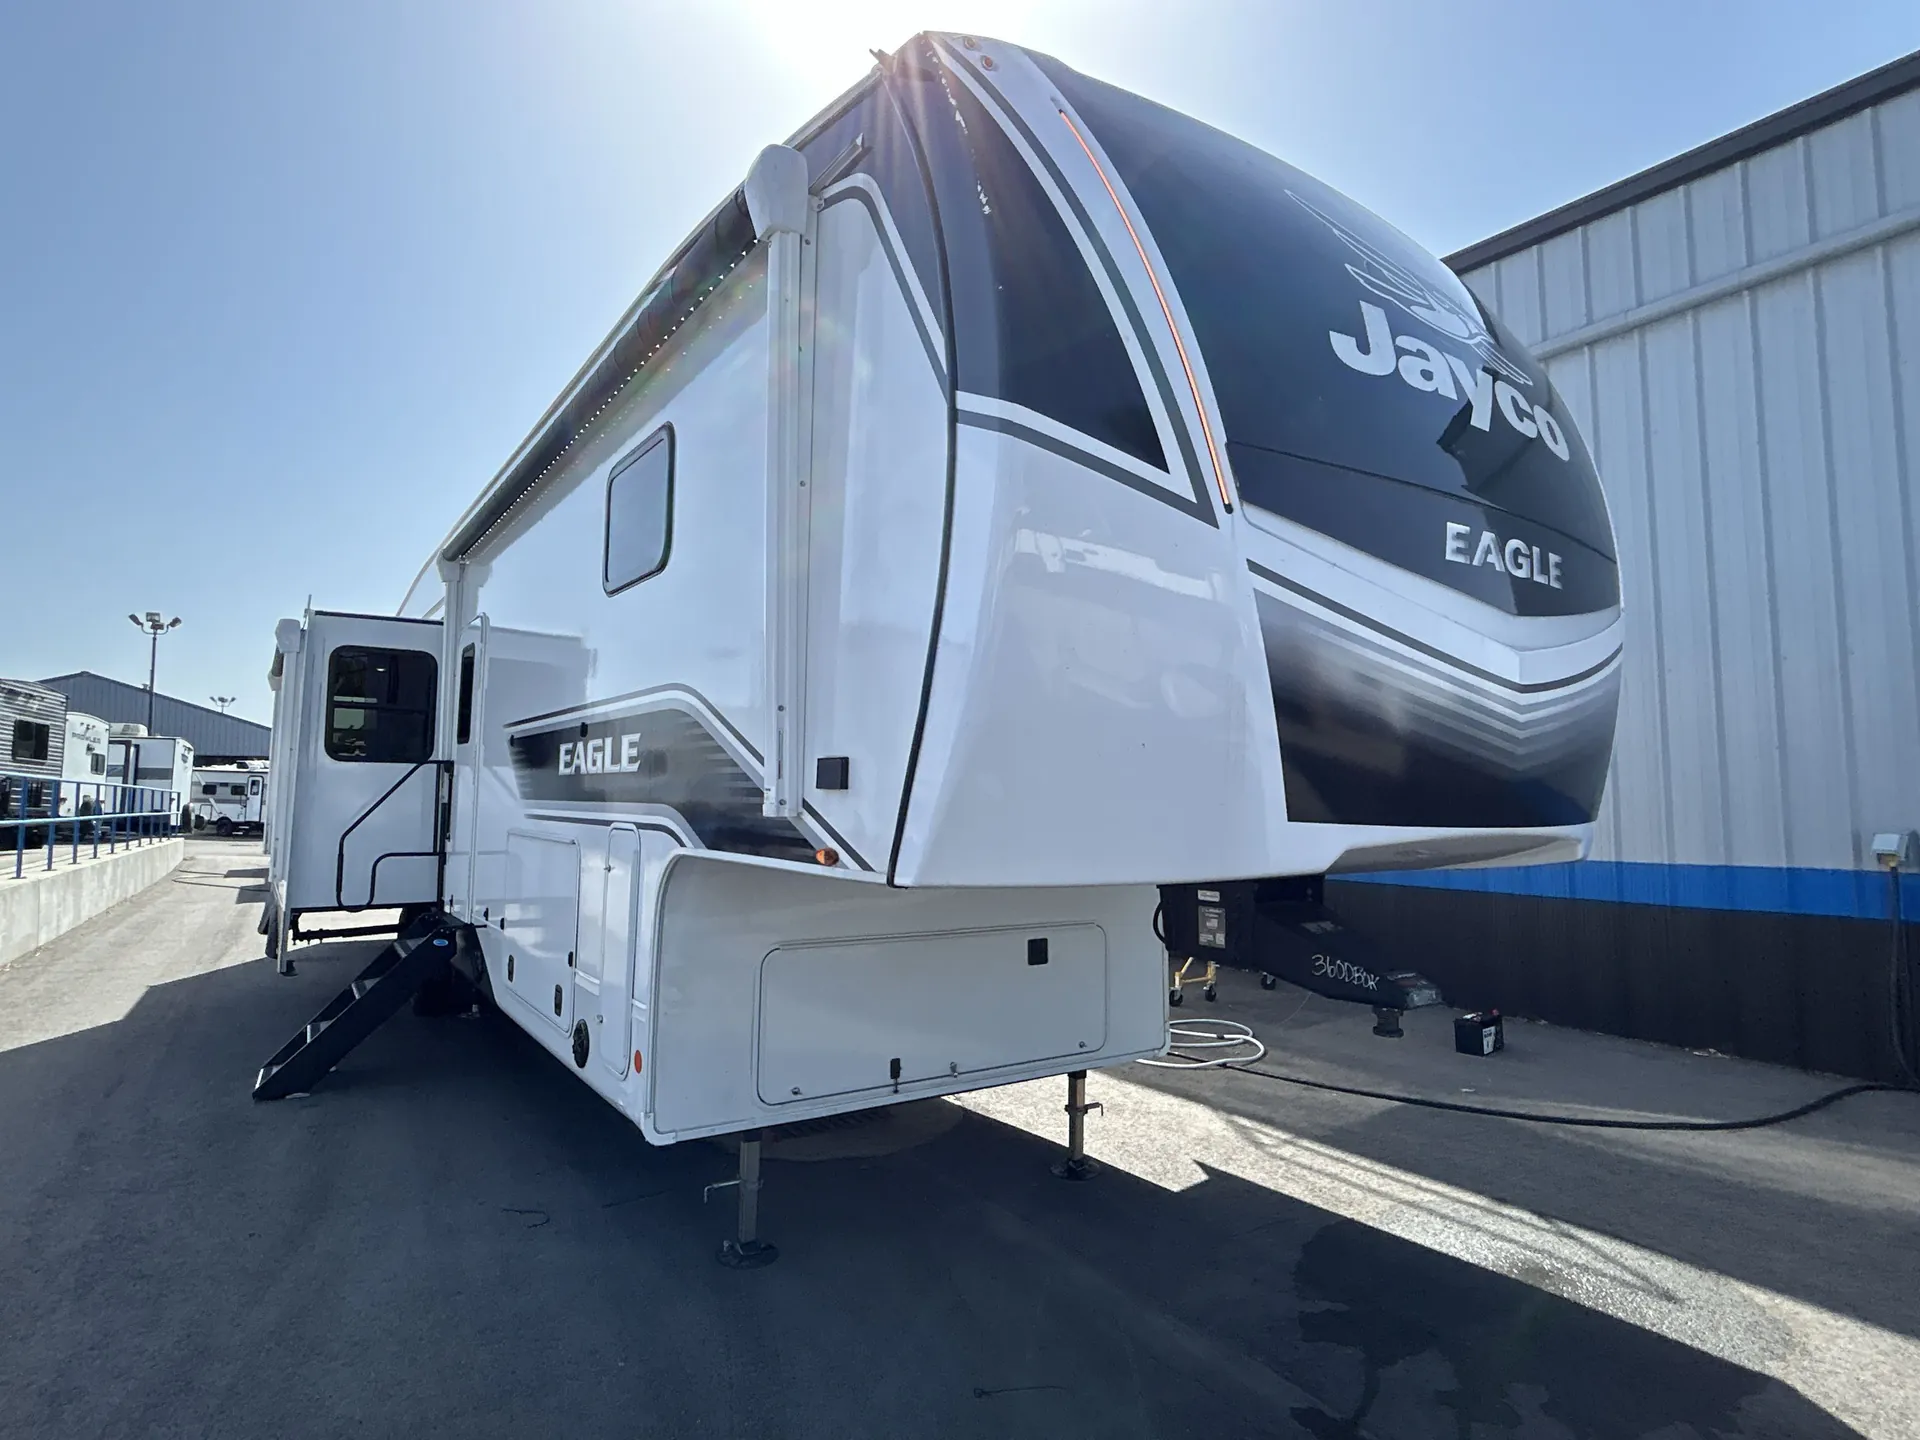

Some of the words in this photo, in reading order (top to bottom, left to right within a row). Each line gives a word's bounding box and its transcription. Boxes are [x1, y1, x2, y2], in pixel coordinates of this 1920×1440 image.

[1329, 299, 1570, 462] Jayco
[1444, 521, 1563, 590] EAGLE
[557, 732, 642, 776] EAGLE
